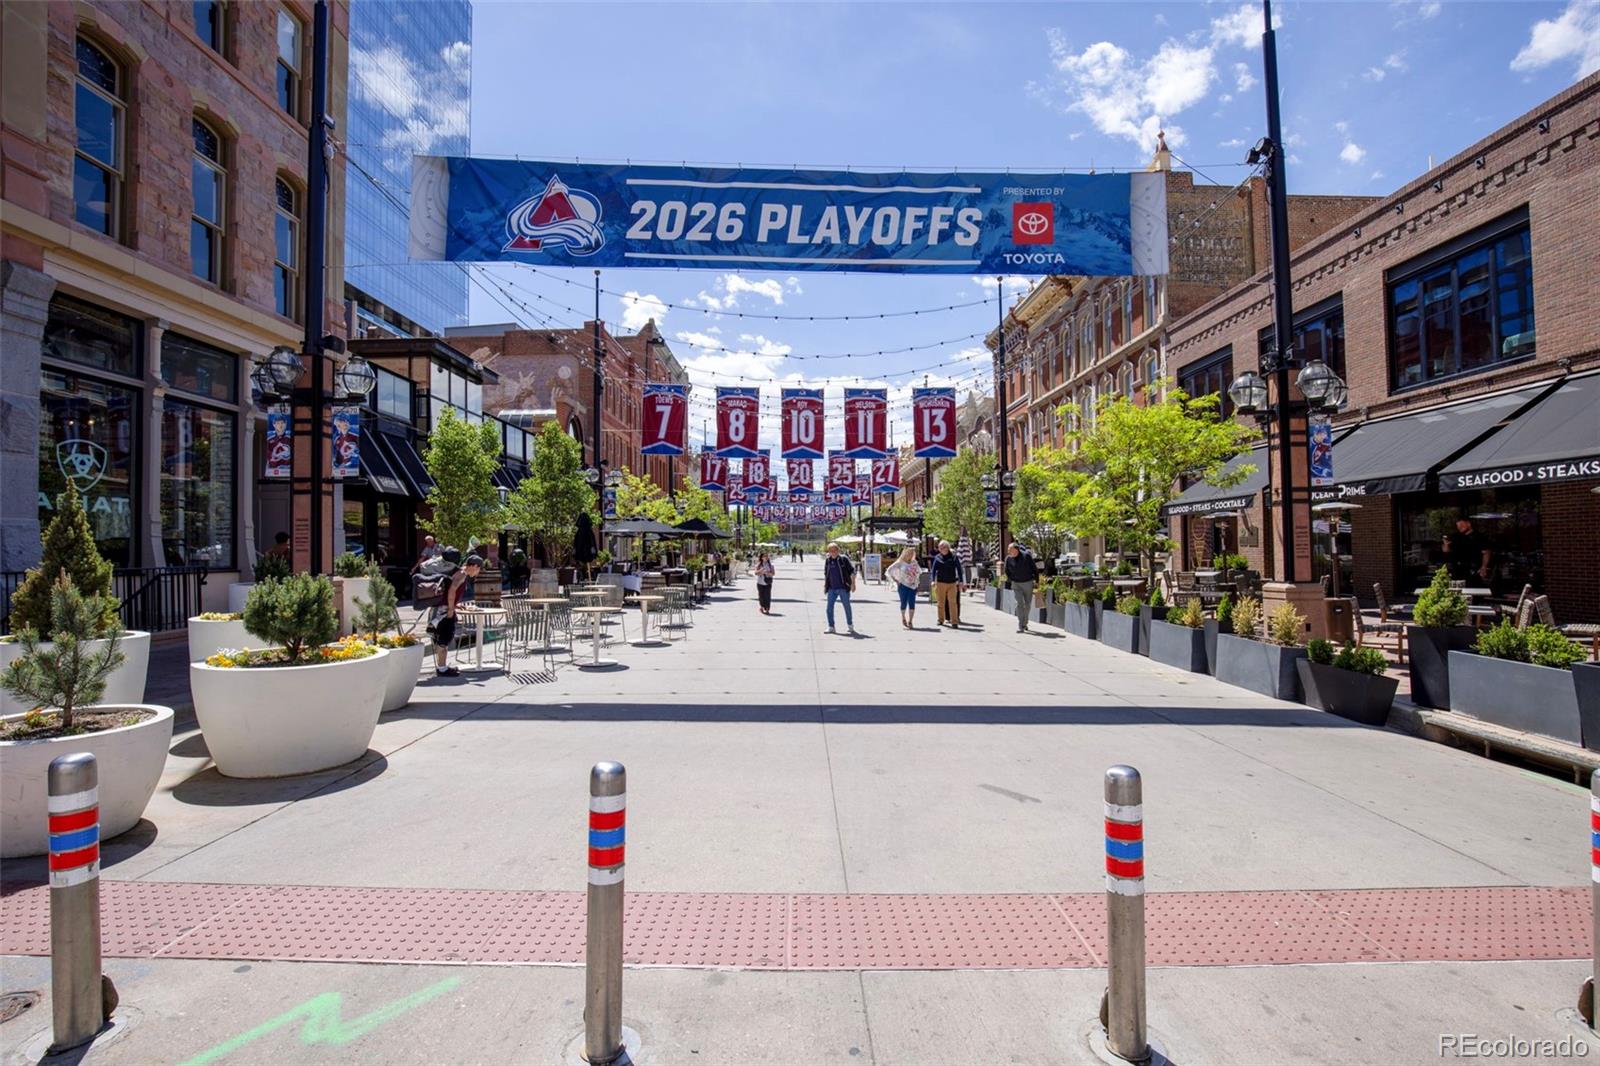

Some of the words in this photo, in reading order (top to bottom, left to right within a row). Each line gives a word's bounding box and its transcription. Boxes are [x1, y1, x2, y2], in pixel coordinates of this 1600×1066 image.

[1002, 186, 1052, 196] PRESENTED
[1053, 187, 1065, 196] BY
[626, 200, 746, 242] 2026
[757, 203, 983, 247] PLAYOFFS
[1003, 253, 1066, 265] TOYOTA
[655, 404, 672, 439] 7
[729, 408, 746, 443] 8
[791, 409, 816, 444] 10
[858, 409, 875, 444] 11
[923, 408, 947, 443] 13
[706, 459, 722, 481] 17
[748, 462, 764, 483] 18
[790, 463, 810, 485] 20
[832, 463, 853, 485] 25
[875, 460, 896, 483] 27
[1458, 470, 1524, 487] SEAFOOD
[1537, 461, 1600, 479] STEAKS
[38, 492, 130, 513] AIAT
[1338, 484, 1366, 499] PRIME
[1168, 505, 1189, 514] SEAFOOD
[1192, 503, 1211, 512] STEAKS
[1214, 499, 1246, 509] COCKTAILS
